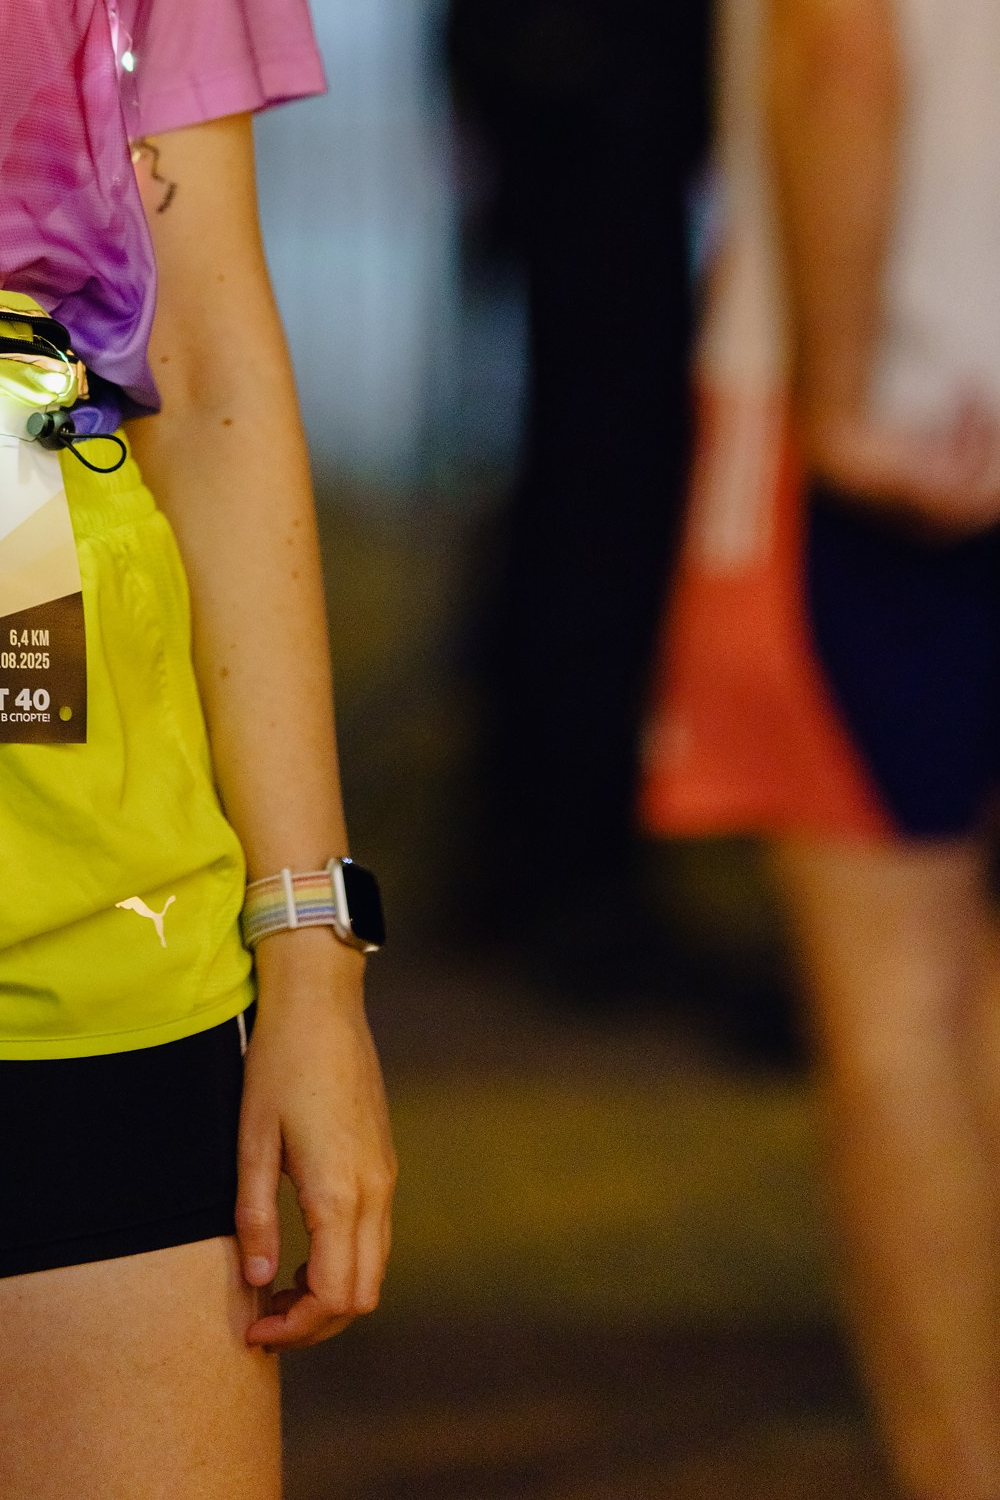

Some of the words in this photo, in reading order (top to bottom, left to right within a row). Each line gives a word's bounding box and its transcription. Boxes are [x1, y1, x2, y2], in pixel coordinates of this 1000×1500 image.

[9, 629, 29, 648] 6,4
[31, 629, 49, 647] КМ
[14, 688, 51, 711] 40
[1, 713, 8, 722] В
[9, 713, 51, 722] СПОРТЕ!
